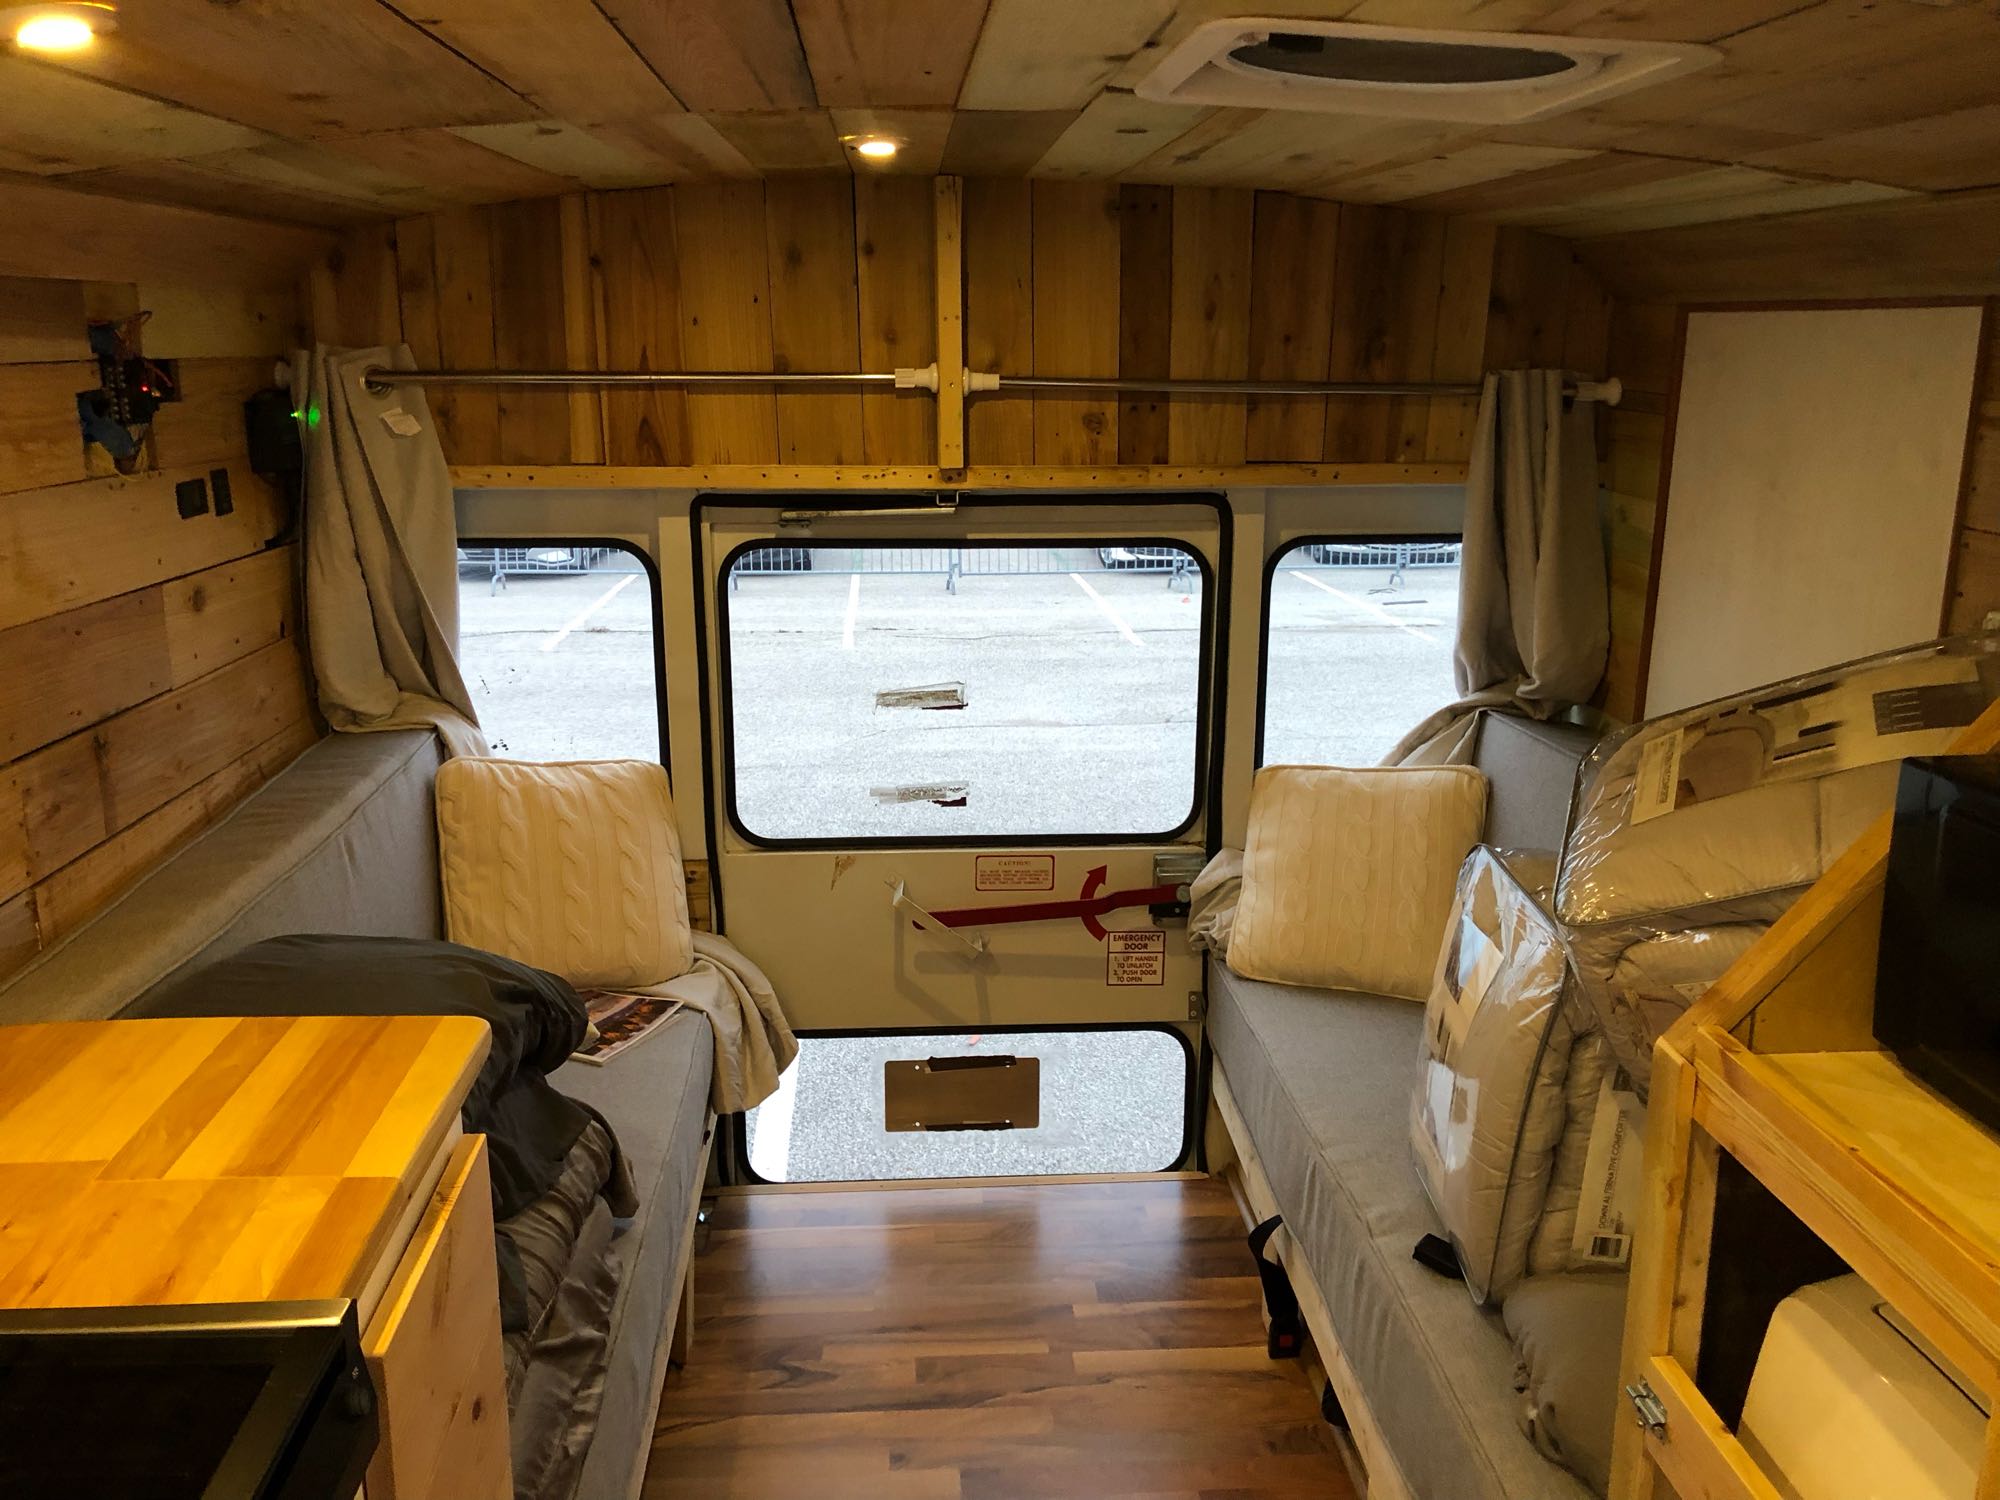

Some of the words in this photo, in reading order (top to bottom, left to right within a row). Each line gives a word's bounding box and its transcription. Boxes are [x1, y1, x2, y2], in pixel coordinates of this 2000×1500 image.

[1113, 934, 1161, 942] EMERGENCY
[1602, 1156, 1617, 1203] ALTERNATIVE
[1599, 1204, 1609, 1229] DOWN
